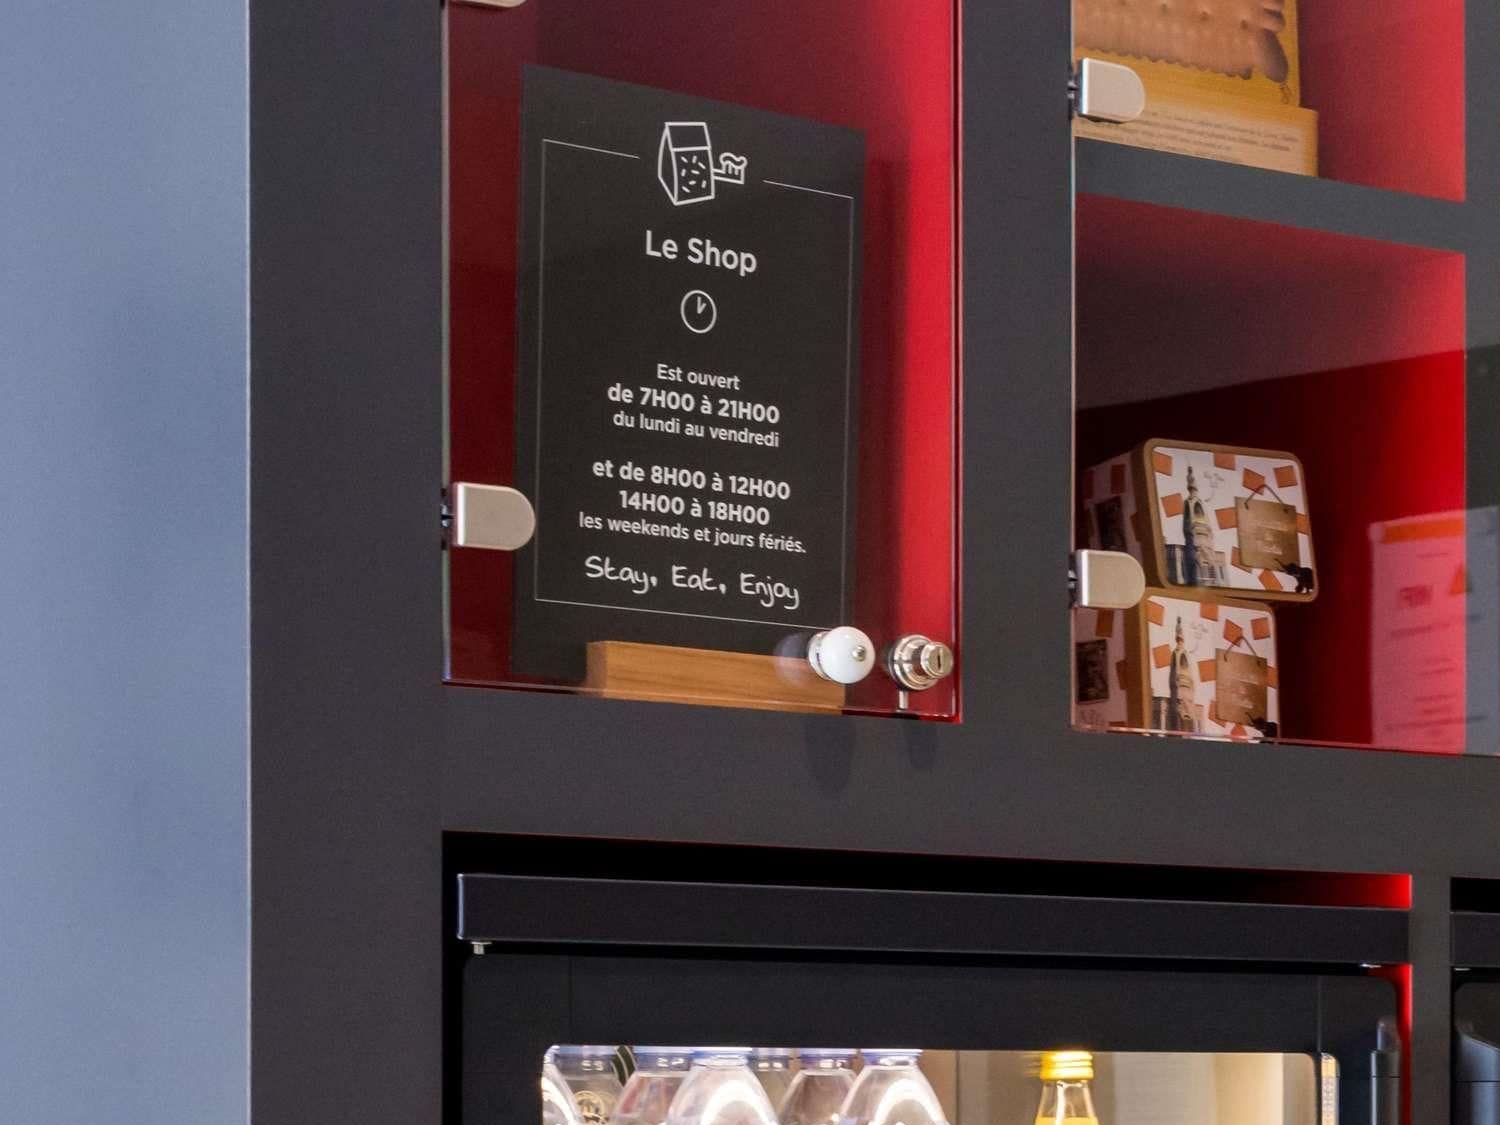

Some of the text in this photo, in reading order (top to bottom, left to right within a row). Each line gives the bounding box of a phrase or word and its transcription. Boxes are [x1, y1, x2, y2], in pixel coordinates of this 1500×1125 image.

[645, 229, 757, 277] Le Shop
[657, 363, 741, 391] Est ouvert
[607, 382, 780, 424] de 7H00 à 21H00
[612, 410, 780, 448] du lundi au vendredi
[592, 459, 791, 500] et de 8H00 à 12H00
[618, 489, 771, 526] 14H00 à 18H00
[579, 511, 603, 531] les
[607, 517, 690, 540] weekends
[694, 526, 711, 543] et
[713, 529, 755, 547] jours
[584, 555, 801, 610] Stay, Eat, Enjoy
